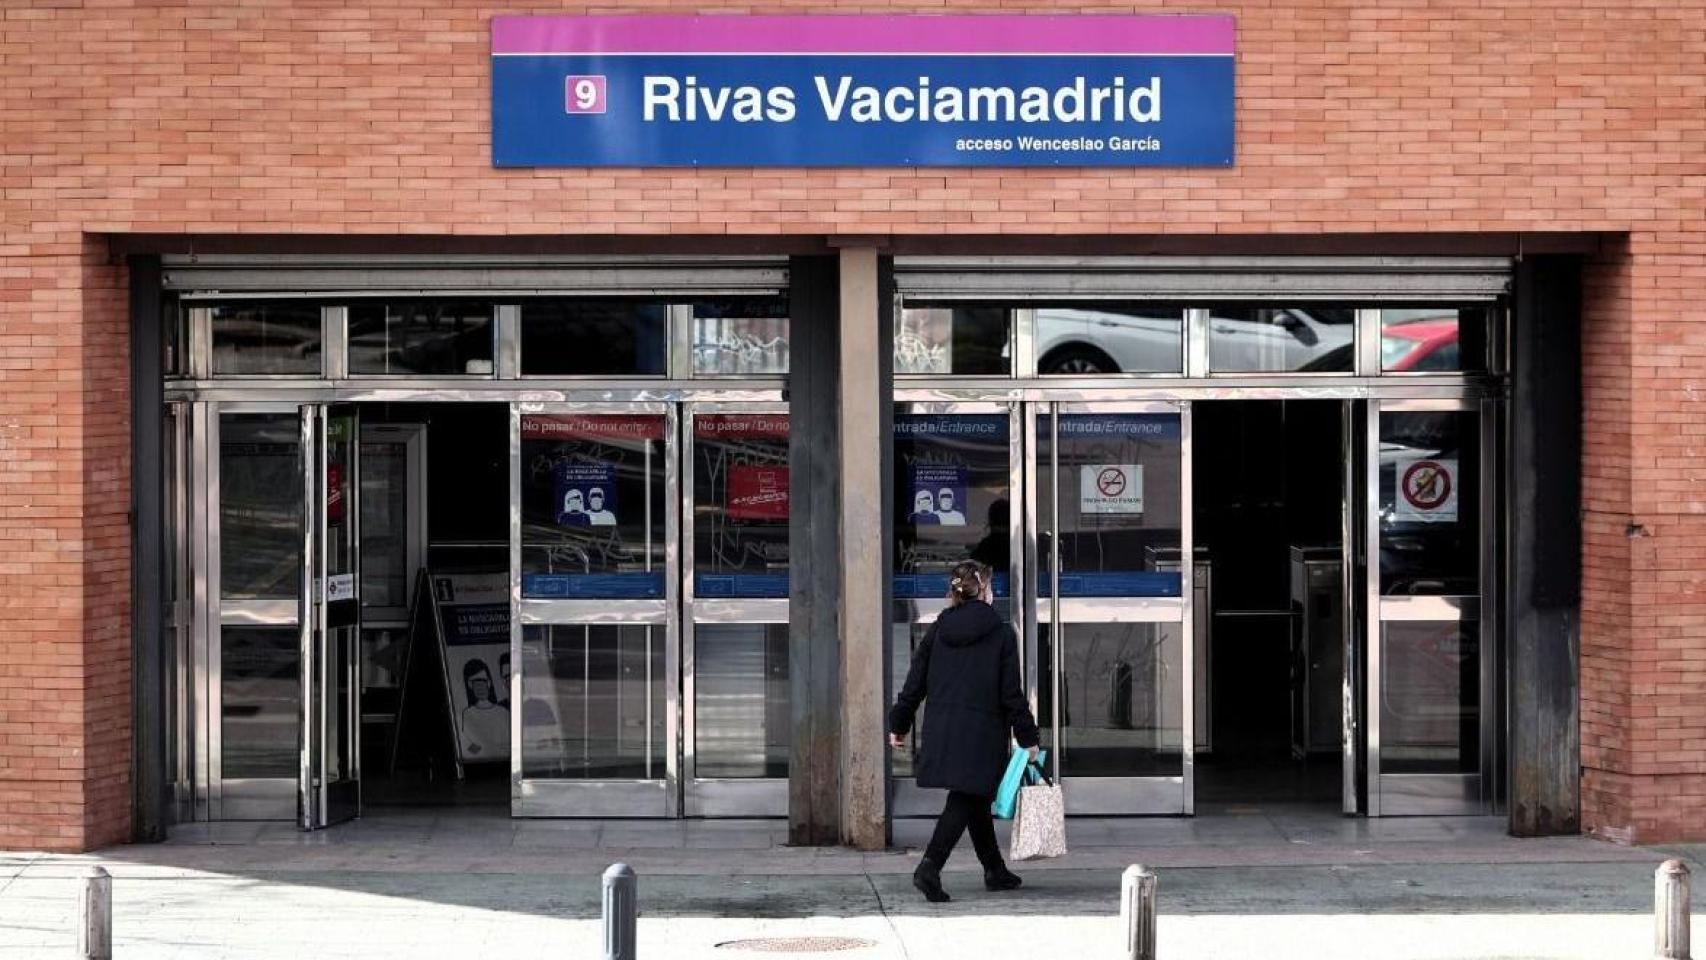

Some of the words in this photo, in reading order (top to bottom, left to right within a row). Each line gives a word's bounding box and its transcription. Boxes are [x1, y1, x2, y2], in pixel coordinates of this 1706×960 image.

[576, 79, 597, 111] 9
[643, 77, 796, 122] Rivas
[815, 76, 1162, 123] Vaciamadrid
[956, 139, 1012, 151] acceso
[1017, 136, 1104, 151] Wenceslao
[1108, 136, 1161, 151] García
[522, 420, 539, 431] No
[542, 422, 574, 433] pasar
[582, 421, 599, 432] Do
[600, 421, 617, 432] not
[698, 420, 714, 431] No
[717, 422, 749, 433] pasar
[758, 420, 773, 431] Do
[775, 420, 790, 431] no
[892, 420, 996, 433] ntrada/Entrance
[1058, 420, 1162, 433] ntrada/Entrance
